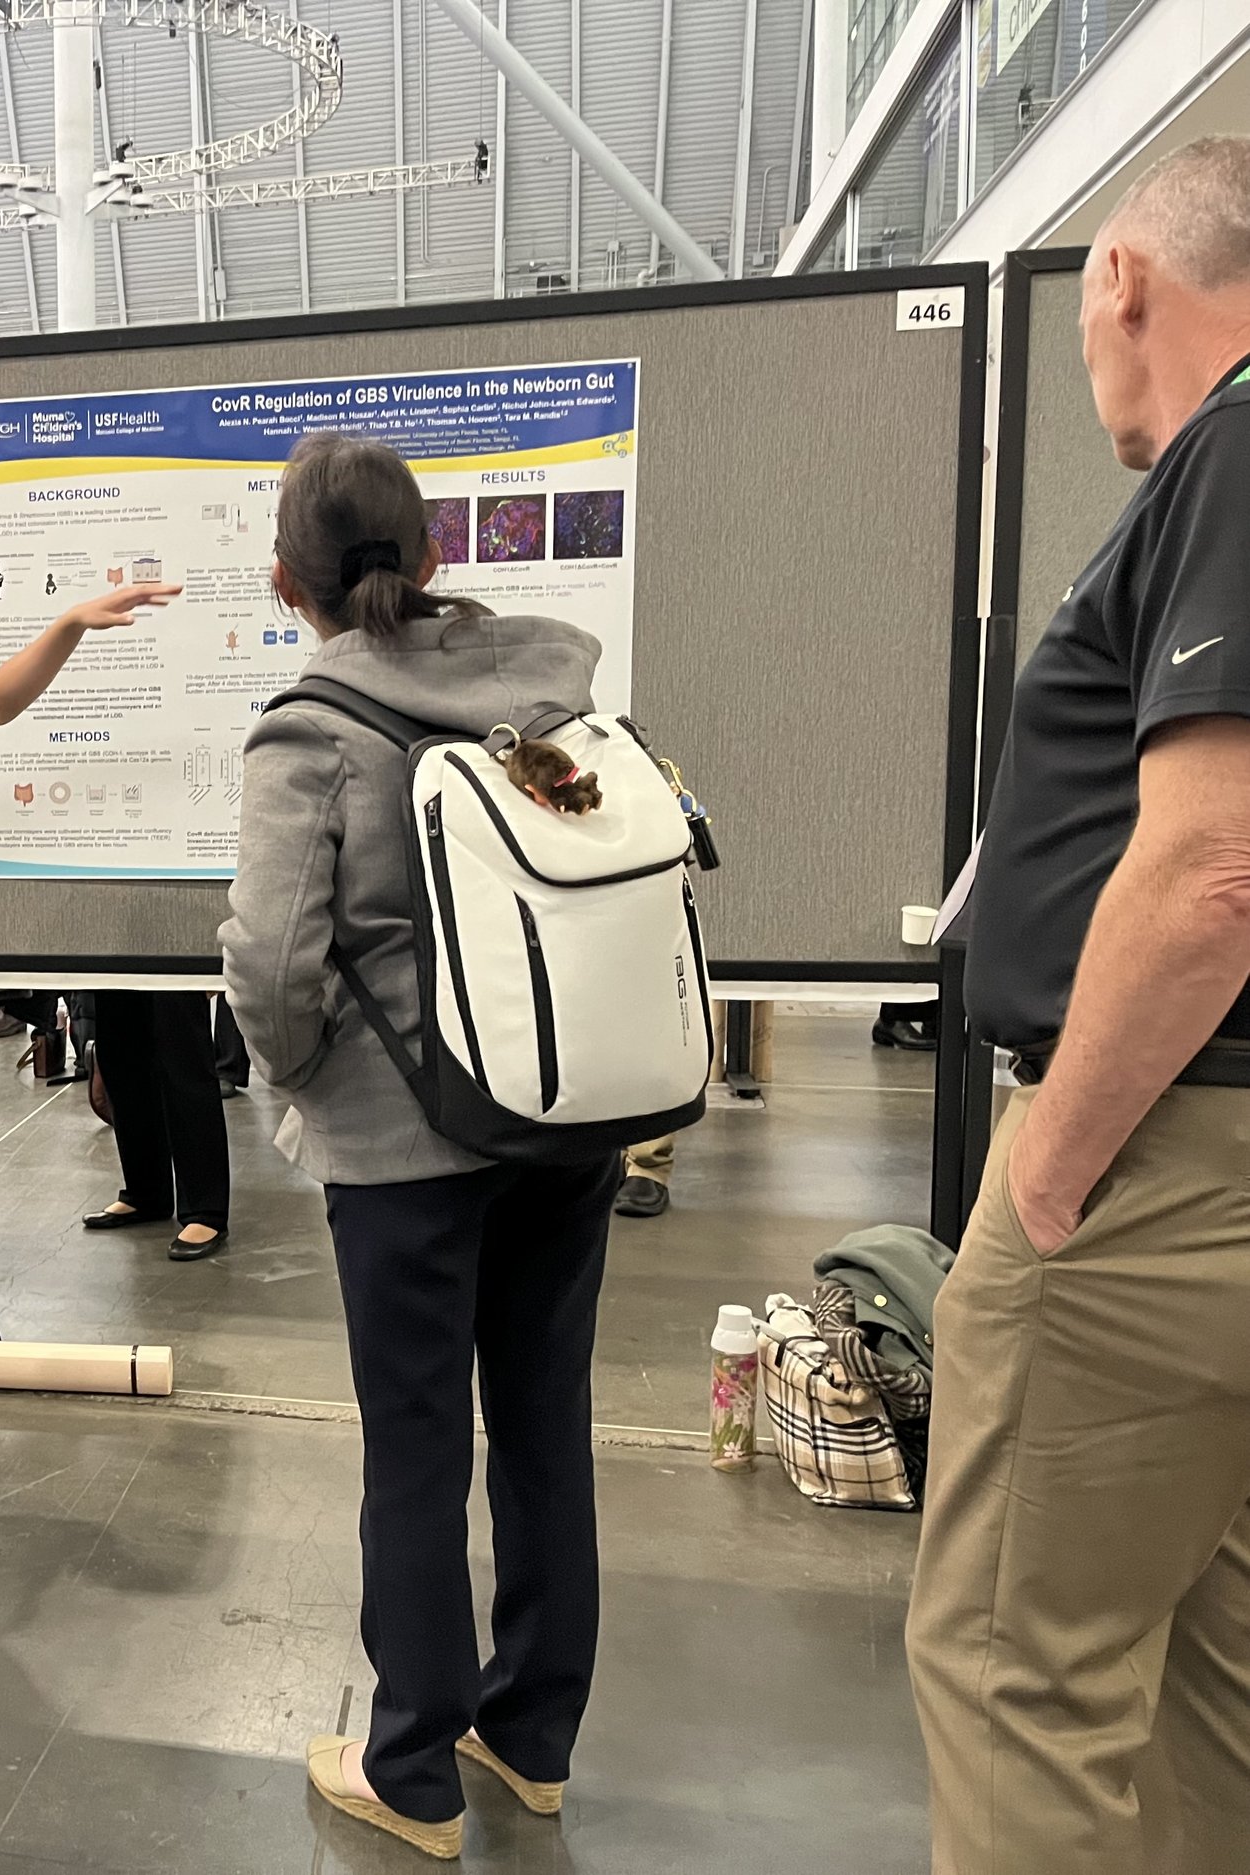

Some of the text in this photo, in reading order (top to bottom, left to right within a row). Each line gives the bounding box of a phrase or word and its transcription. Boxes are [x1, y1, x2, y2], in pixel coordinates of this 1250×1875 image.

[908, 303, 951, 322] 446
[212, 375, 614, 413] CovR Regulation of GBS Virulence in the Newborn Gut
[32, 412, 64, 422] Muma
[426, 417, 456, 426] Thomas
[32, 421, 82, 433] Children's
[32, 432, 74, 444] Hospital
[481, 470, 546, 485] RESULTS
[248, 480, 283, 491] METH
[28, 487, 120, 502] BACKGROUND
[50, 732, 110, 742] METHODS
